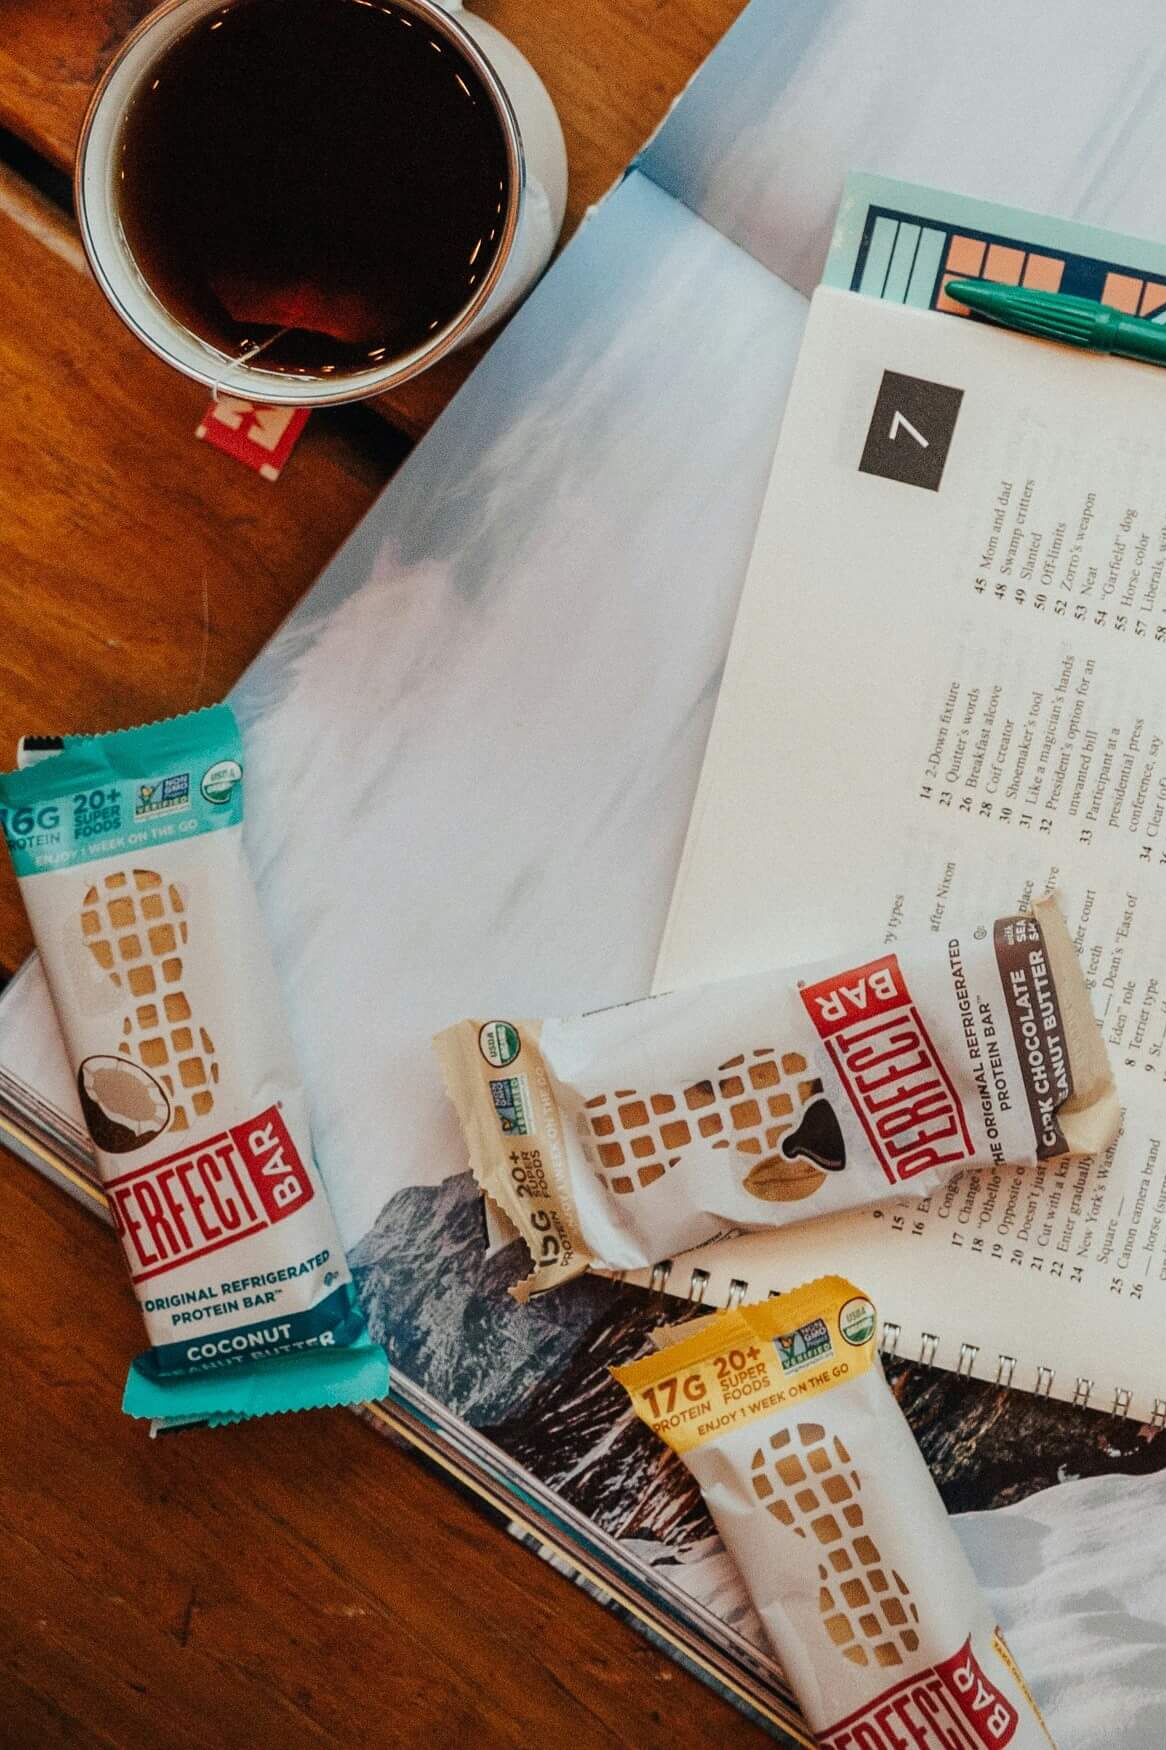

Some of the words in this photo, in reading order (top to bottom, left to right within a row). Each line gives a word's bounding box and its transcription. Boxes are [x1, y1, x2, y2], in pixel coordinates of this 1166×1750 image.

[888, 410, 930, 449] 7
[996, 480, 1014, 507] dad
[1015, 478, 1036, 526] critters
[992, 507, 1007, 534] and
[978, 535, 1000, 571] Mom
[999, 527, 1025, 577] Swamp
[1018, 531, 1044, 582] Slanted
[1039, 521, 1068, 587] Off-limits
[1093, 609, 1109, 628] 54
[1118, 507, 1139, 533] dog
[1133, 531, 1151, 568] color
[973, 575, 988, 595] 45
[993, 582, 1009, 601] 48
[1013, 584, 1028, 606] 49
[1079, 565, 1099, 597] Neat
[1119, 568, 1141, 608] Horse
[1033, 593, 1049, 613] 50
[1072, 604, 1089, 622] 53
[1112, 613, 1129, 633] 55
[982, 684, 1003, 727] alcove
[964, 728, 992, 789] Breakfast
[995, 718, 1015, 764] creator
[984, 763, 1004, 795] Coif
[73, 788, 121, 815] 20+
[74, 805, 121, 827] SUPER
[958, 796, 974, 814] 26
[978, 800, 993, 819] 28
[74, 819, 122, 840] FOODS
[814, 968, 898, 1022] BAR
[948, 938, 981, 1058] REFRIGERATED
[1029, 949, 1059, 1029] BUTTER
[1141, 977, 1160, 1007] type
[1009, 969, 1049, 1094] CHOCOLATE
[1127, 1007, 1151, 1051] Terrier
[985, 1041, 1013, 1111] PROTEIN
[1123, 1057, 1137, 1068] 8
[836, 1015, 964, 1181] PERFECT
[973, 1062, 1000, 1139] ORIGINAL
[248, 1121, 303, 1208] BAR
[509, 1150, 534, 1199] 20+
[520, 1151, 539, 1198] SUPER
[531, 1149, 551, 1199] FOODS
[1140, 1137, 1161, 1176] brand
[1131, 1178, 1151, 1225] camera
[531, 1210, 561, 1268] 15G
[1116, 1227, 1138, 1270] Canon
[145, 1286, 218, 1313] ORIGINAL
[221, 1250, 331, 1298] REFRIGERATED
[1109, 1276, 1124, 1295] 25
[172, 1302, 239, 1326] PROTEIN
[187, 1324, 291, 1362] COCONUT
[803, 1327, 827, 1343] GMO
[713, 1345, 761, 1379] 20+
[720, 1362, 767, 1392] SUPER
[640, 1375, 707, 1419] 17G
[698, 1412, 737, 1436] ENJOY
[750, 1392, 786, 1416] WEEK
[788, 1380, 808, 1398] ON
[808, 1371, 831, 1389] THE
[831, 1362, 850, 1379] GO
[723, 1376, 771, 1405] FOODS
[653, 1401, 712, 1434] PROTEIN
[951, 1656, 1011, 1738] BAR
